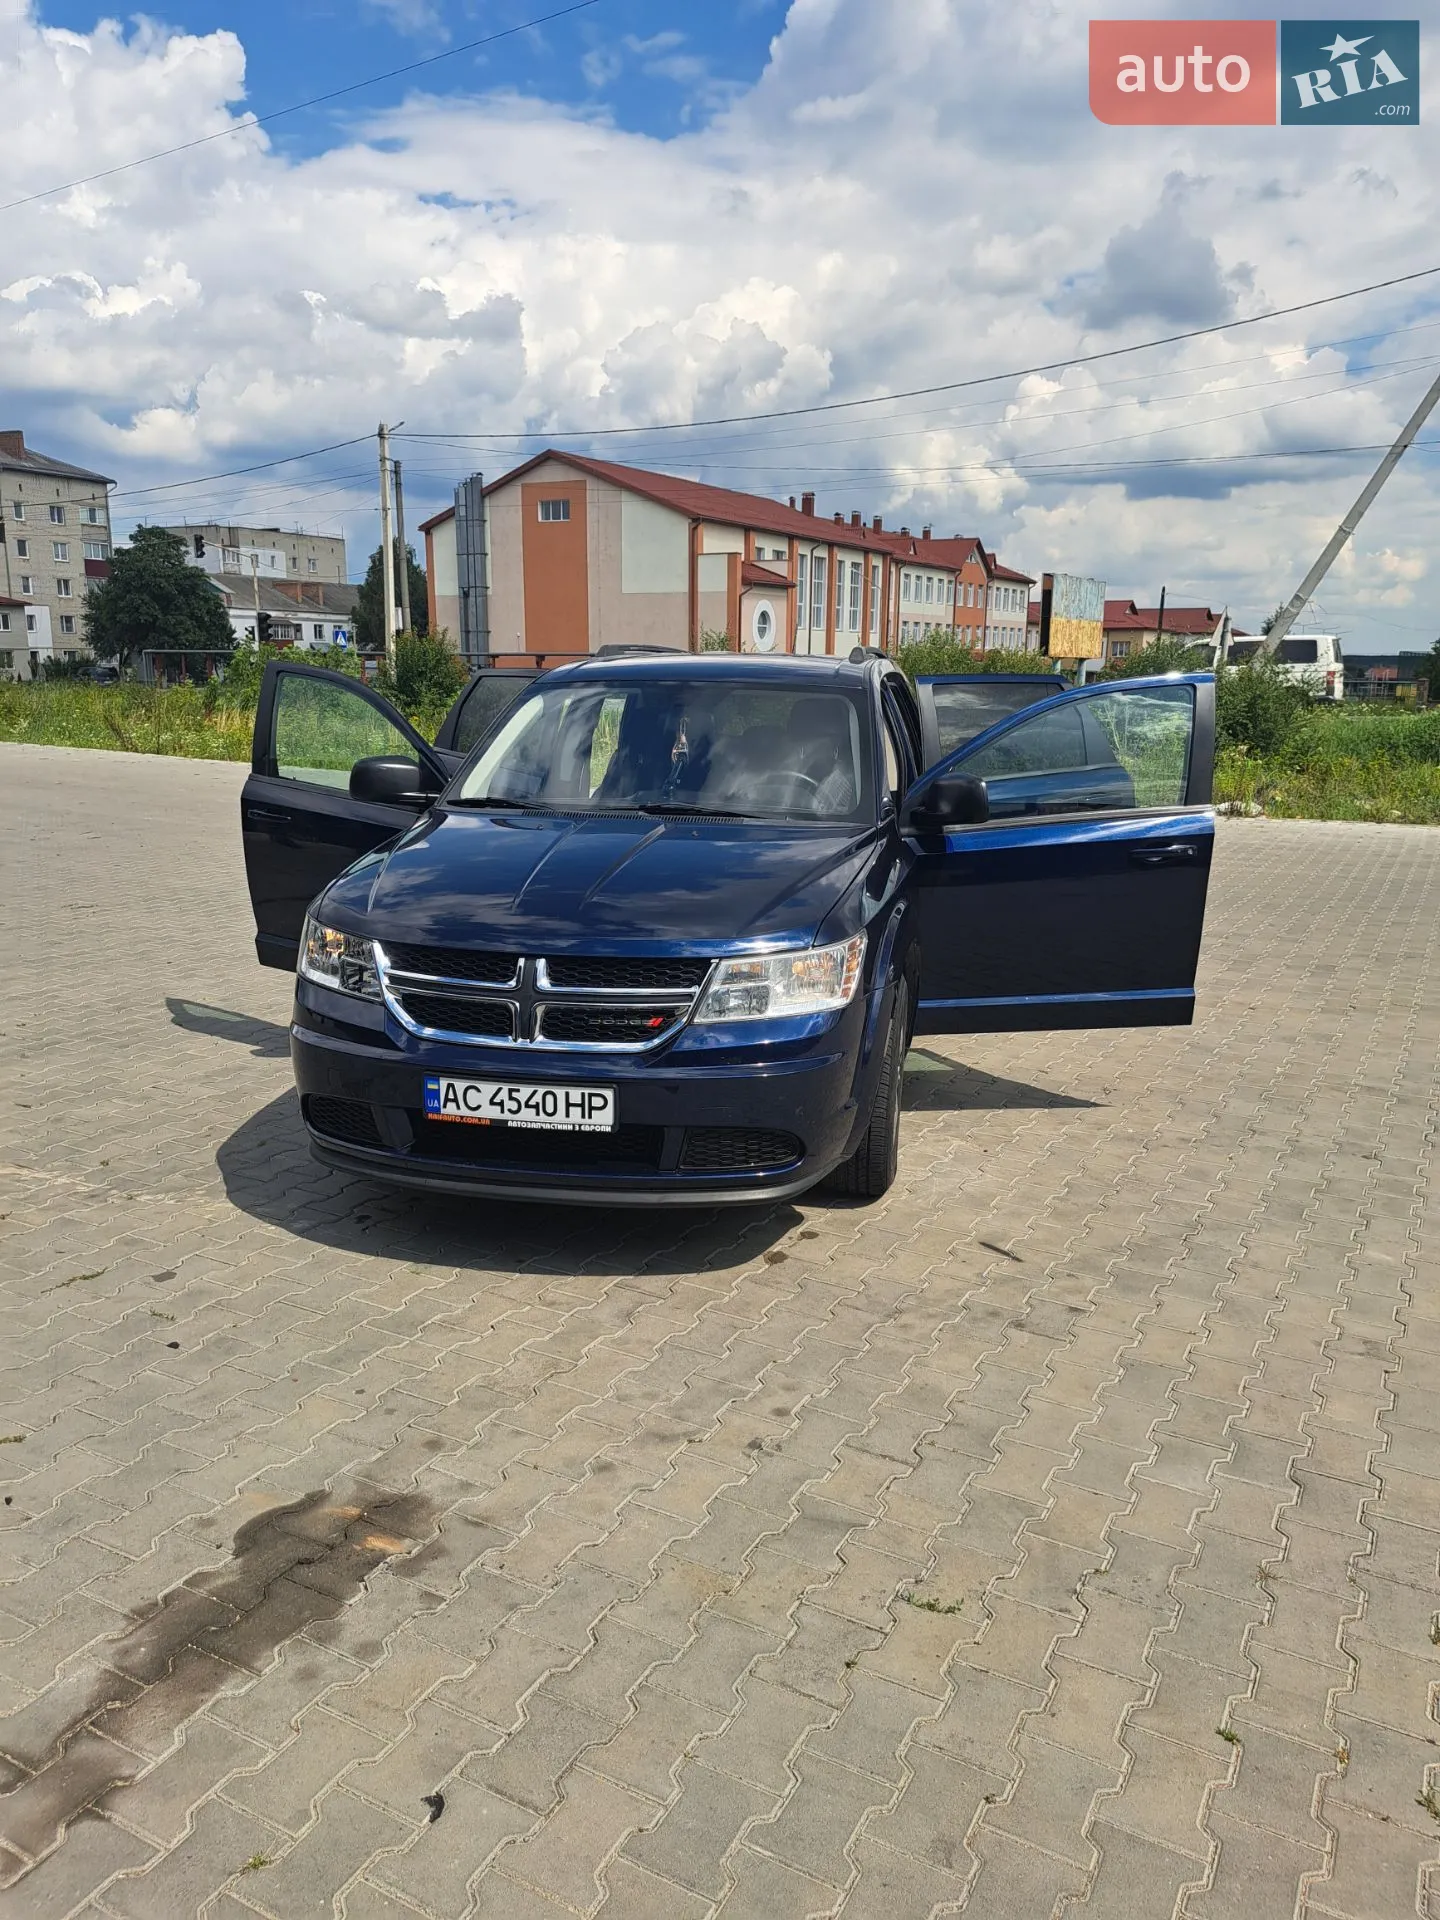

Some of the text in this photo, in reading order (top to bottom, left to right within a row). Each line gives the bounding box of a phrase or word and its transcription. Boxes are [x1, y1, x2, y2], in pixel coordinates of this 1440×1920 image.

[427, 1098, 440, 1108] UA
[442, 1082, 609, 1119] AC 4540 HP
